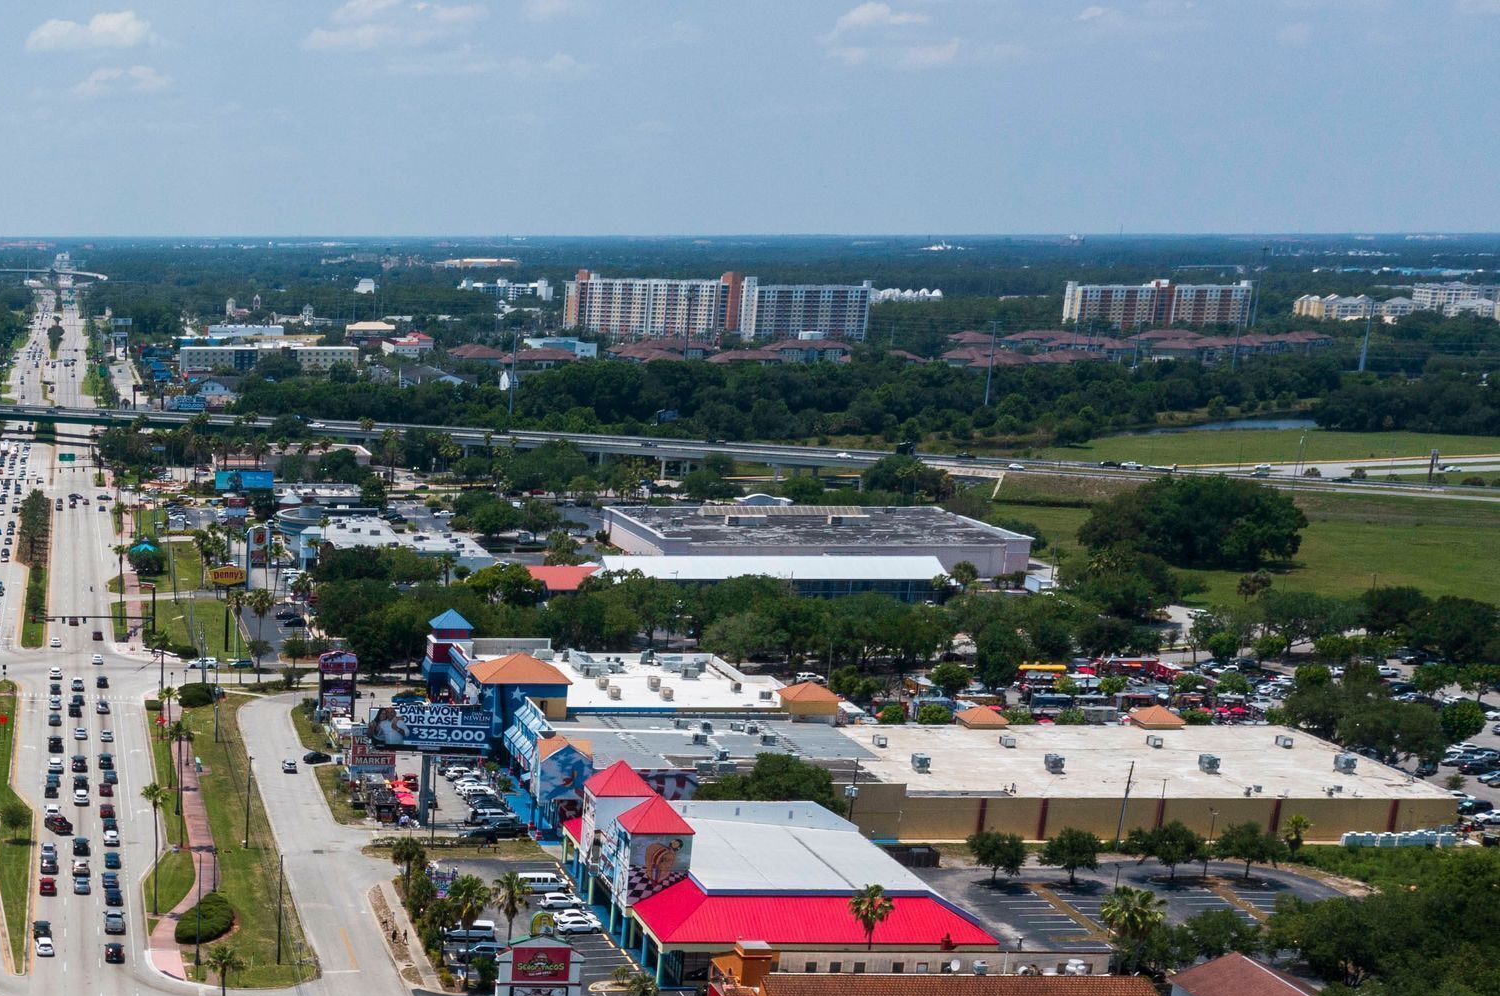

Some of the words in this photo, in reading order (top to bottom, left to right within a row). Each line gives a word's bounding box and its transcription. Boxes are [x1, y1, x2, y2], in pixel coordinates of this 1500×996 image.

[213, 571, 244, 579] Denny's
[400, 705, 425, 715] DAN
[429, 706, 460, 716] WON
[401, 715, 425, 724] OUR
[427, 716, 459, 726] CASE
[412, 727, 486, 742] $325,000
[355, 757, 392, 765] MARKET
